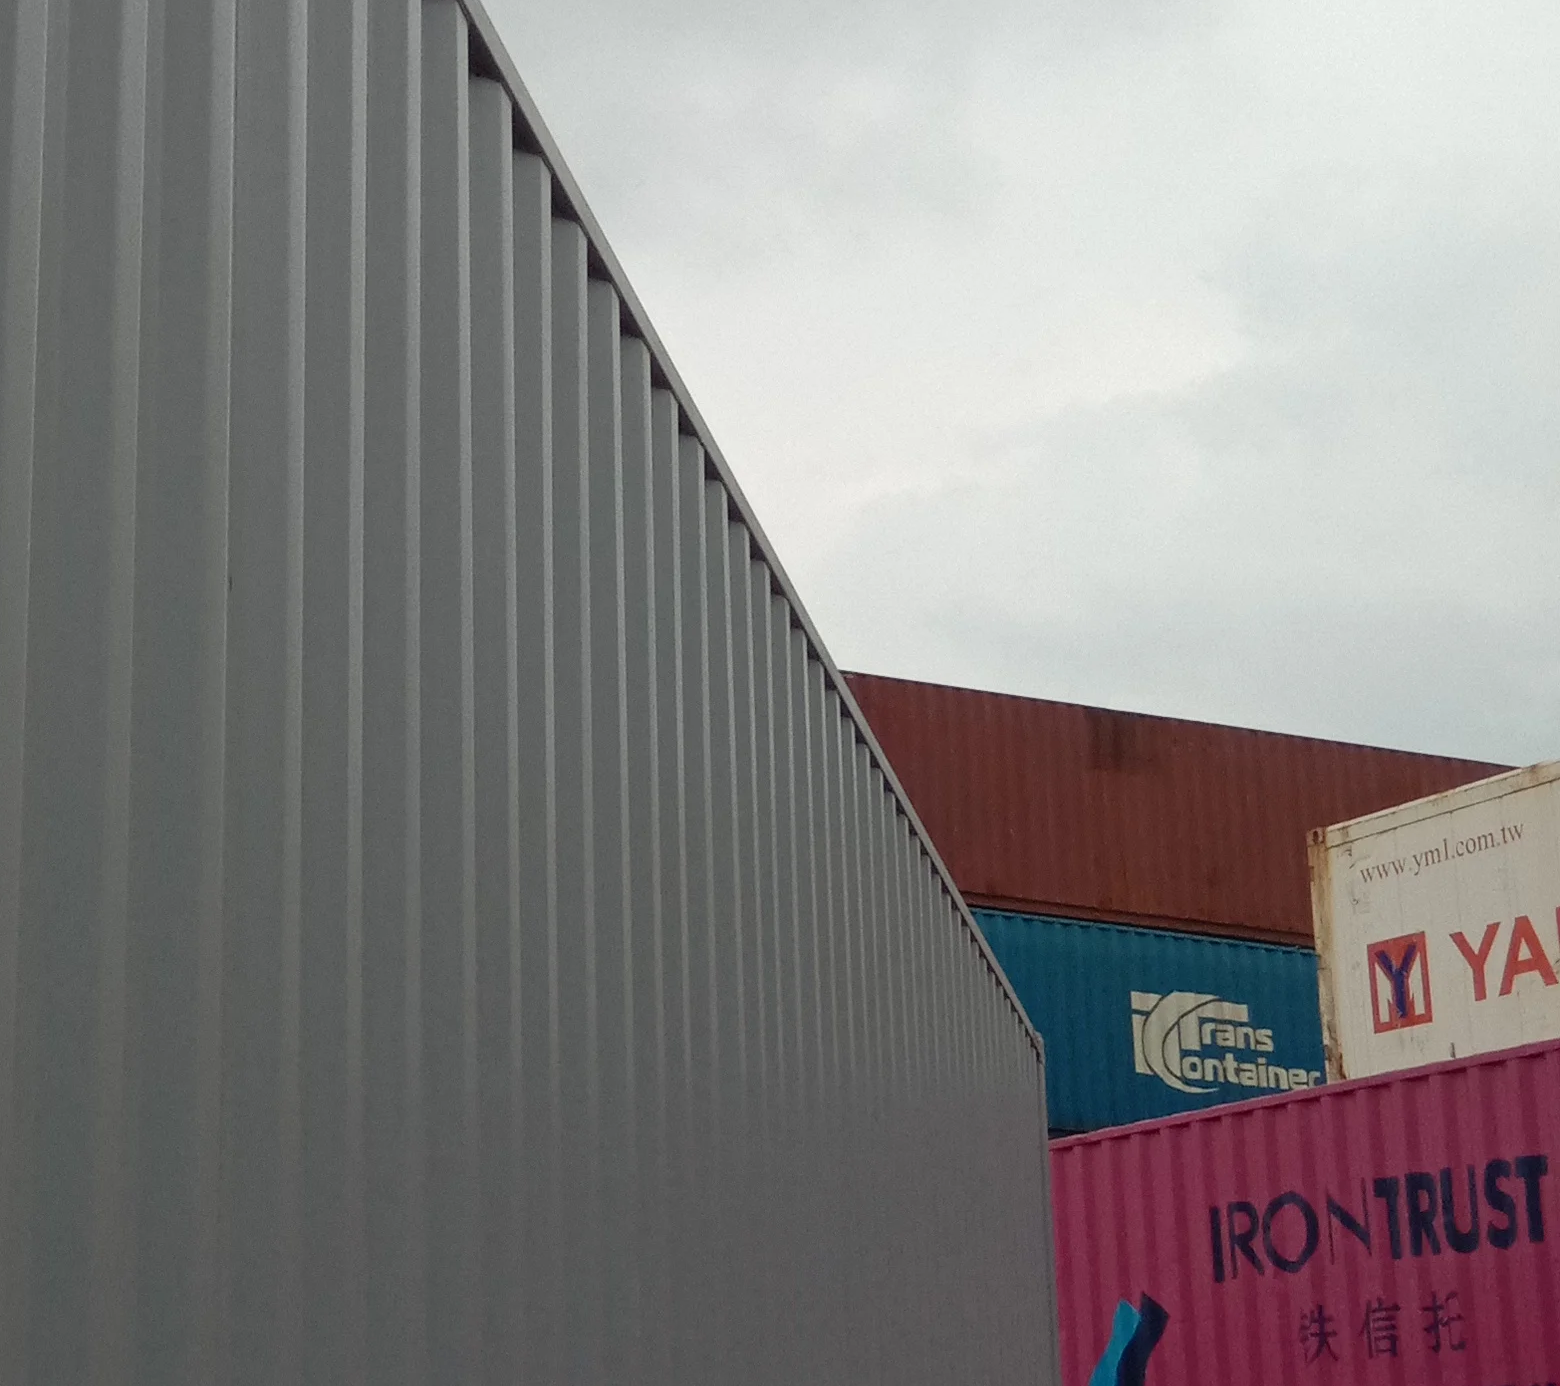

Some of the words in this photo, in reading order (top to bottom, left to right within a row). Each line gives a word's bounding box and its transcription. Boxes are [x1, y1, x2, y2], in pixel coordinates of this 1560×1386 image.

[1359, 823, 1525, 884] www.yml.com.tw
[1448, 905, 1560, 1002] YA
[1208, 1154, 1549, 1284] IRONTRUST
